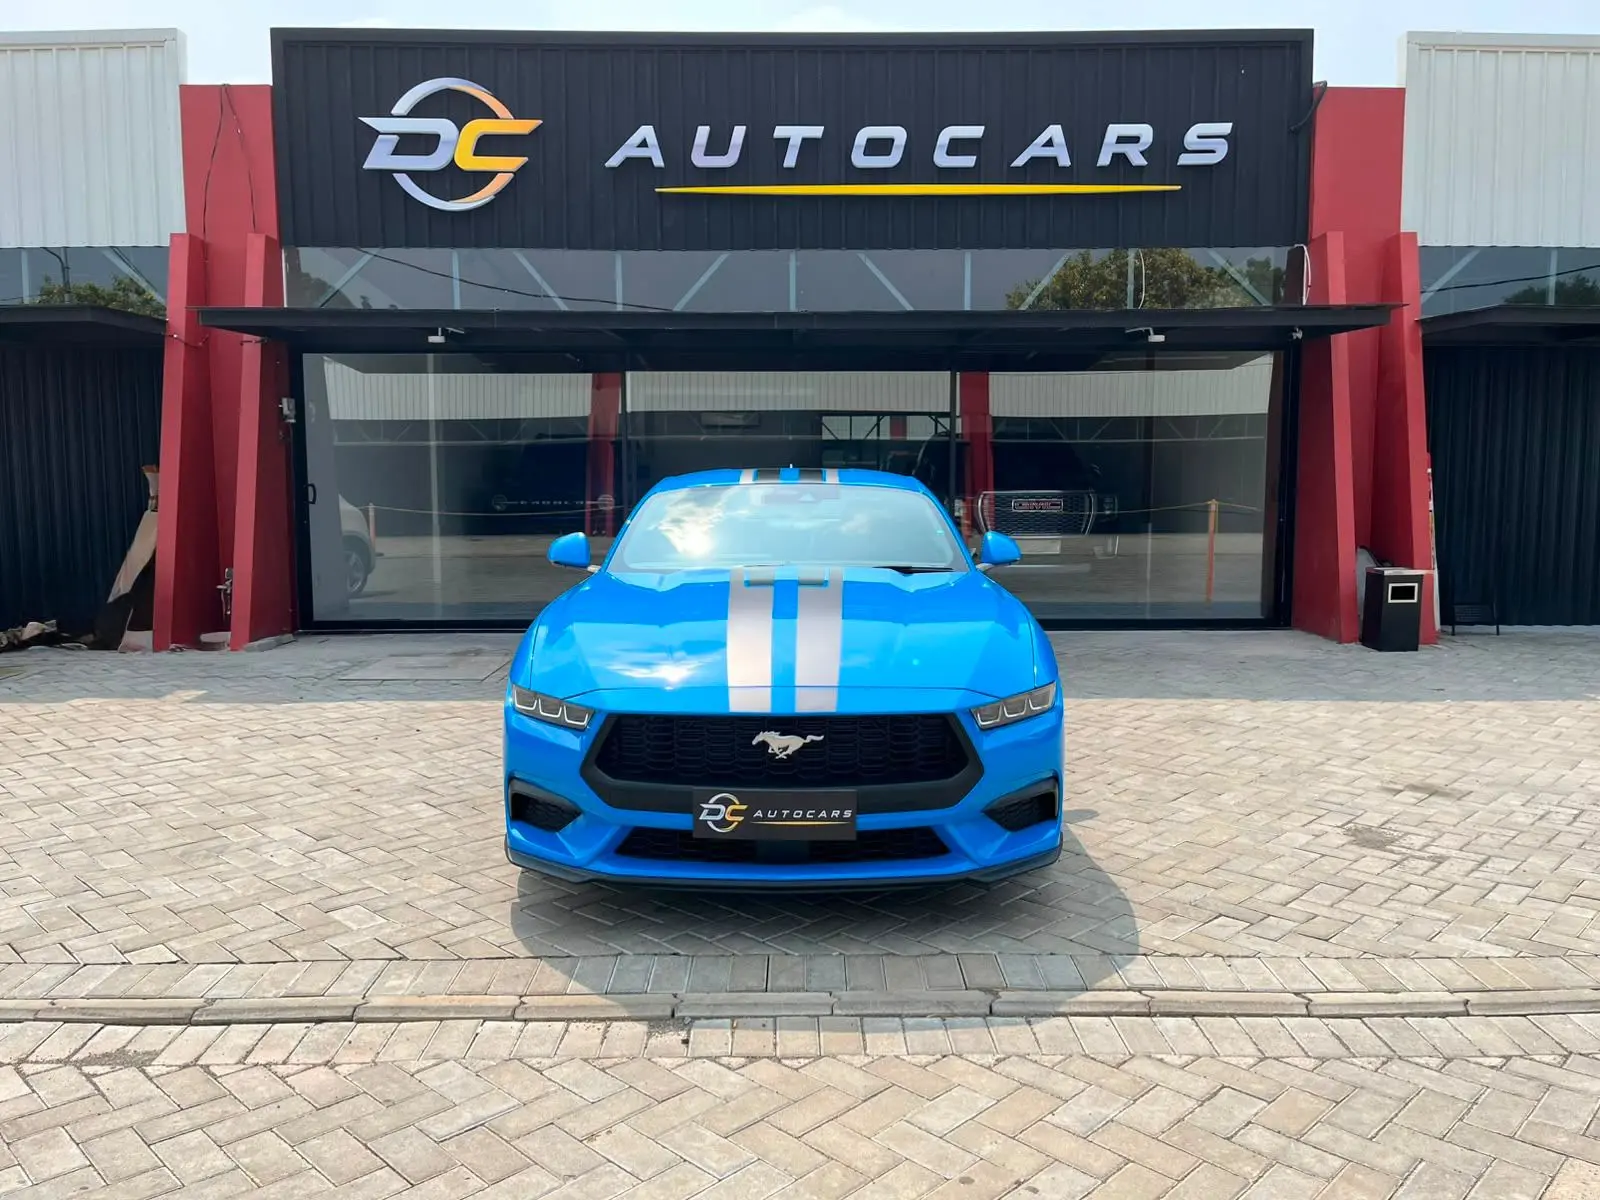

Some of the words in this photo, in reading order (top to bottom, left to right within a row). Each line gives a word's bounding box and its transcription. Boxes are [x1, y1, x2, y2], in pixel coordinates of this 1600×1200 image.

[357, 116, 543, 172] DC
[604, 121, 1234, 169] AUTOCARS
[699, 803, 748, 822] DC
[752, 809, 853, 819] AUTOCARS
